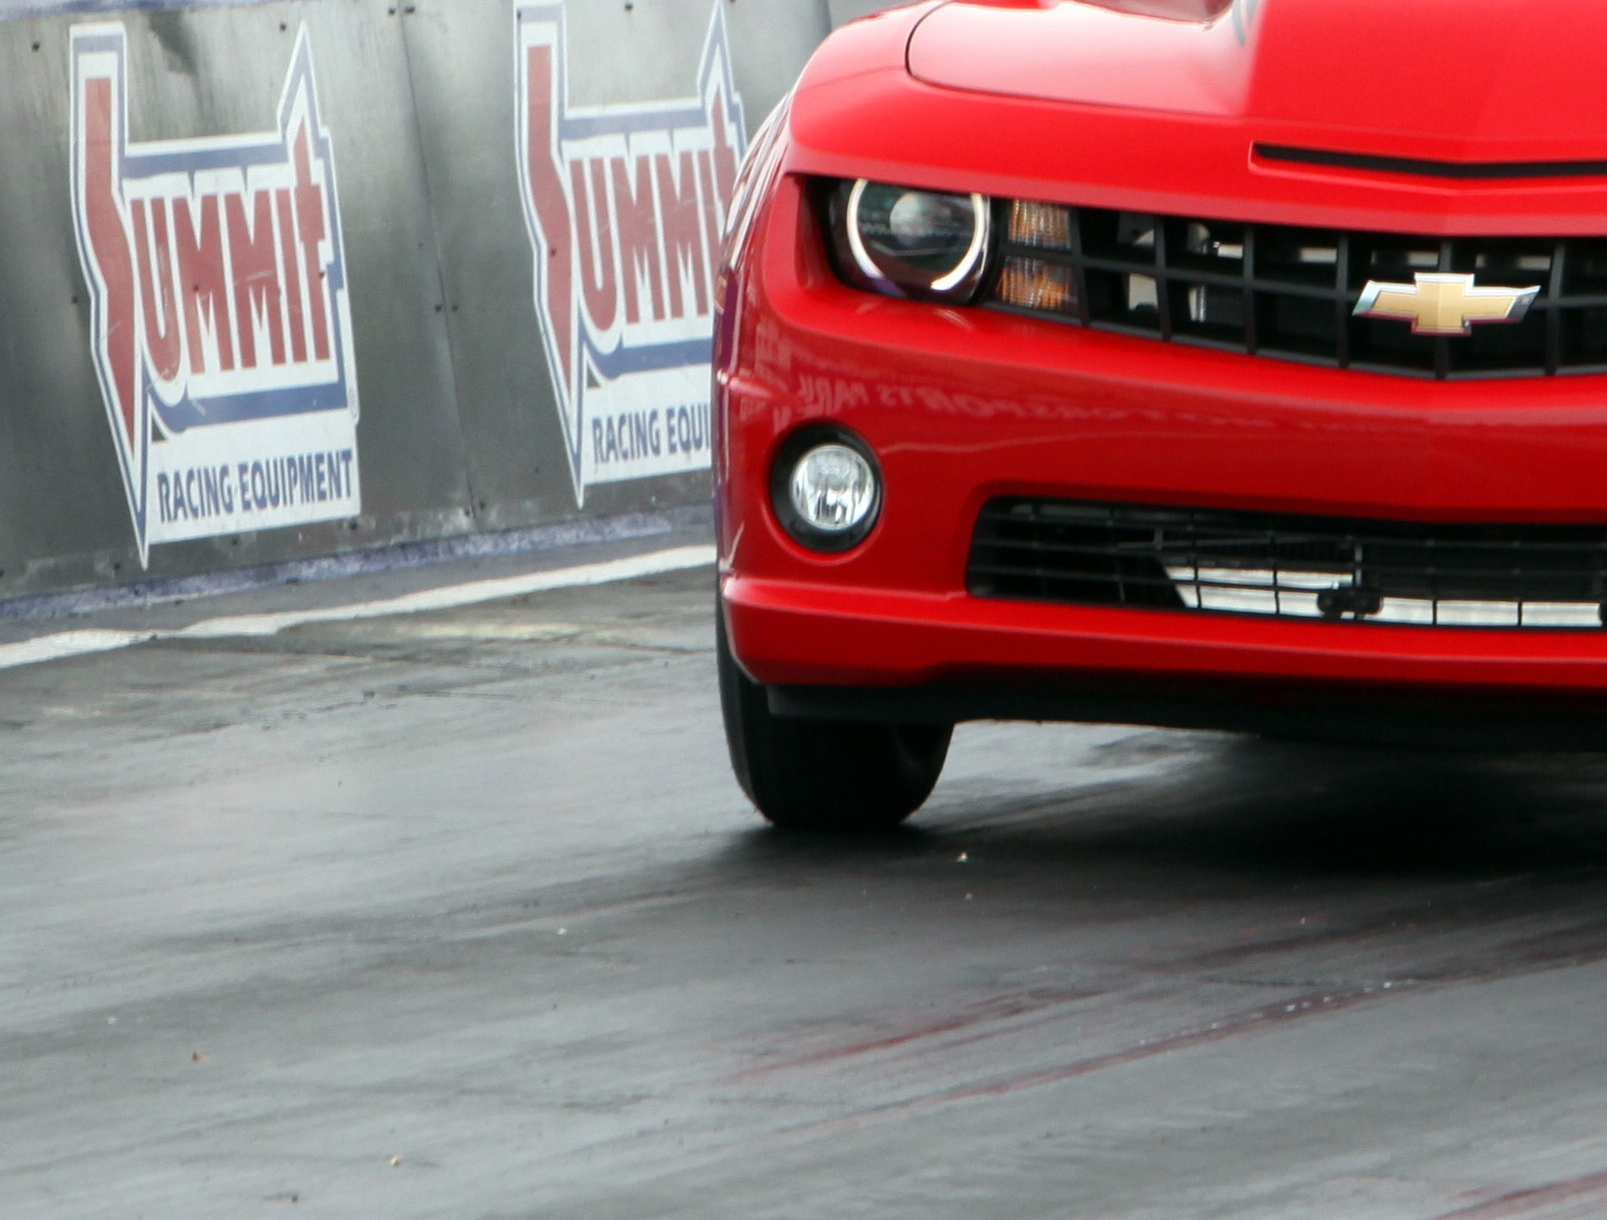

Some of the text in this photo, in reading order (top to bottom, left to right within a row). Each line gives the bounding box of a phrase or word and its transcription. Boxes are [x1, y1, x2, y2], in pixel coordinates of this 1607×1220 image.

[83, 76, 332, 454] SUMMIT
[591, 408, 662, 464] RACING
[157, 448, 354, 524] RACING EQUIPMENT
